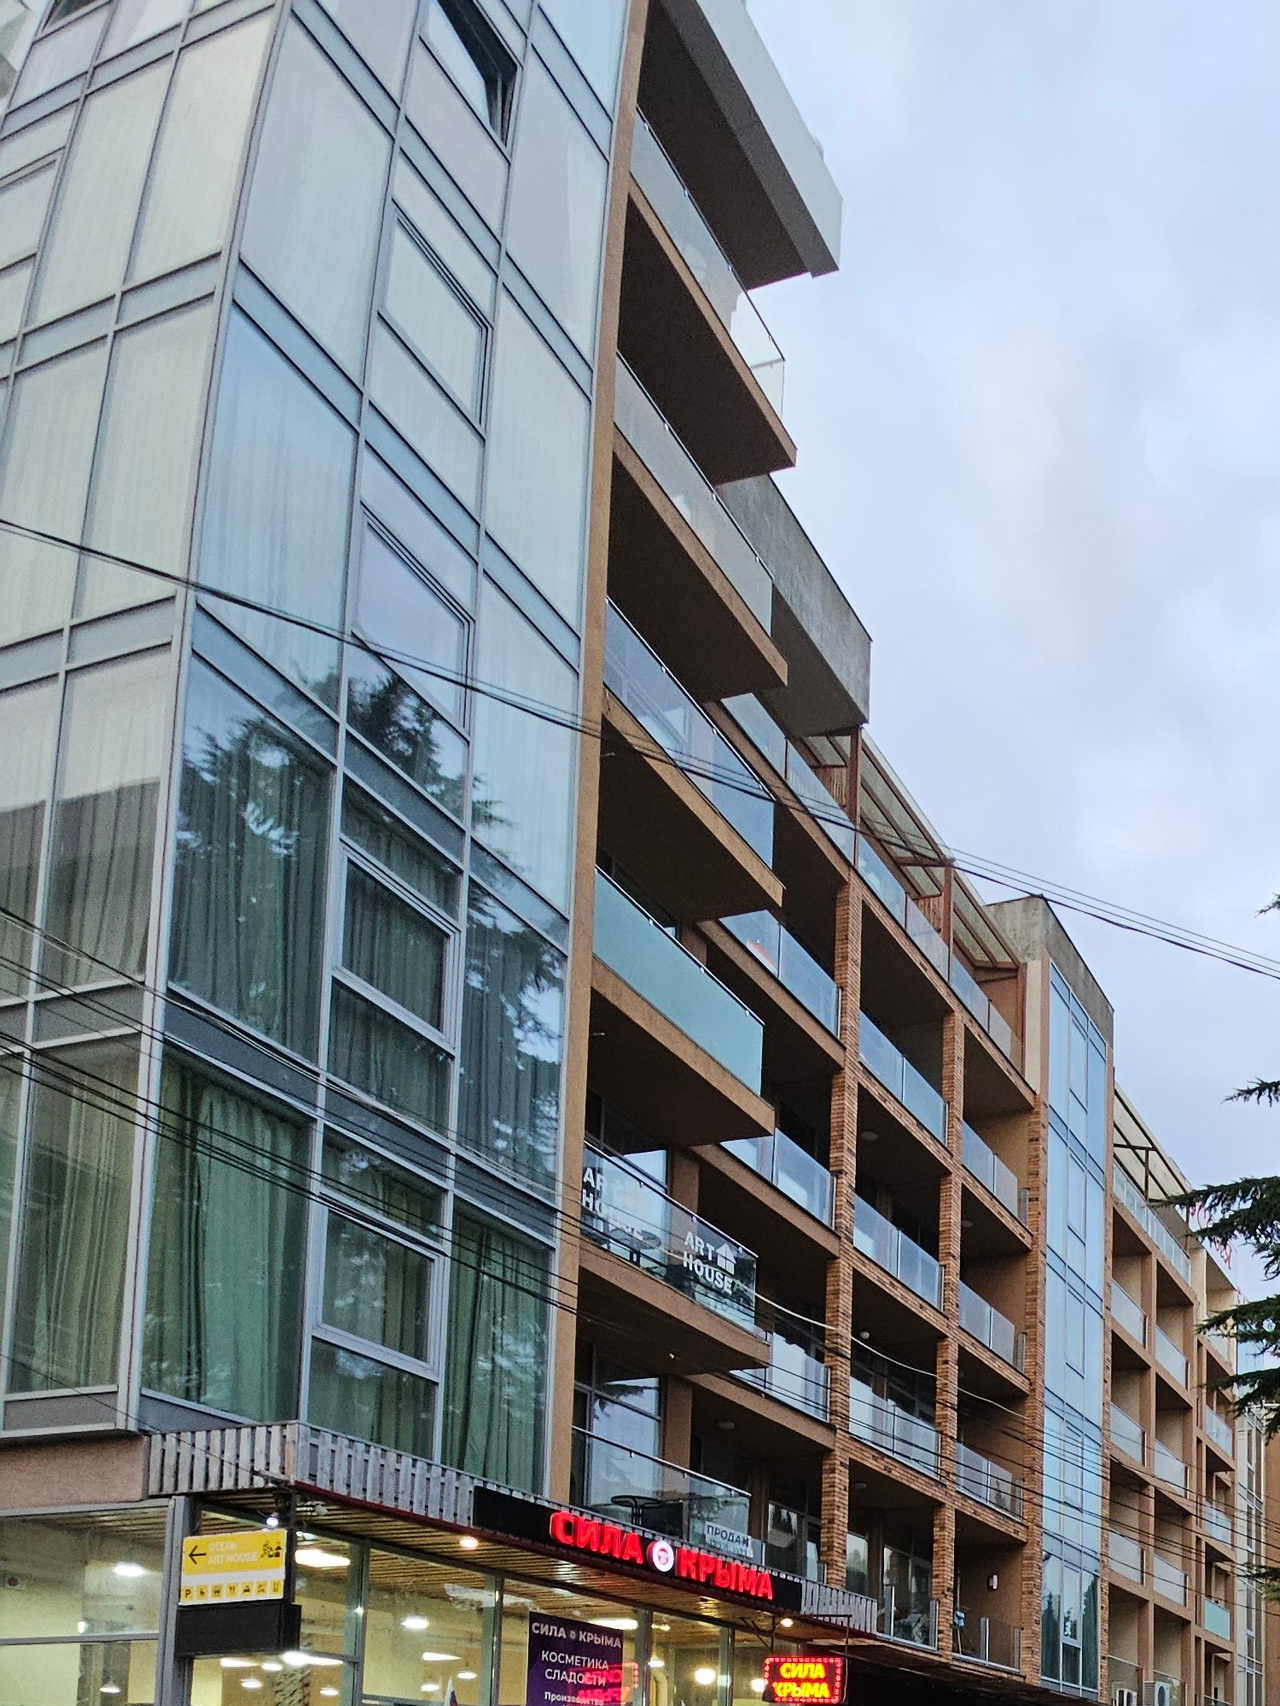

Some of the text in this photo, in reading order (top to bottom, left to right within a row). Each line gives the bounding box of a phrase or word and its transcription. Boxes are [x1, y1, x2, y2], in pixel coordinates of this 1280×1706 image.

[685, 1231, 715, 1261] ART
[683, 1251, 733, 1295] HOUSE
[226, 1551, 258, 1562] HOUSE
[550, 1510, 774, 1600] СИЛА КРЫМА
[531, 1622, 622, 1648] СИЛА КРЫМА
[541, 1650, 609, 1670] КОСМЕТИКА
[545, 1669, 607, 1687] СЛАДОСТИ
[780, 1663, 826, 1679] СИЛА
[544, 1691, 605, 1706] Производство
[772, 1682, 830, 1698] КРЫМА
